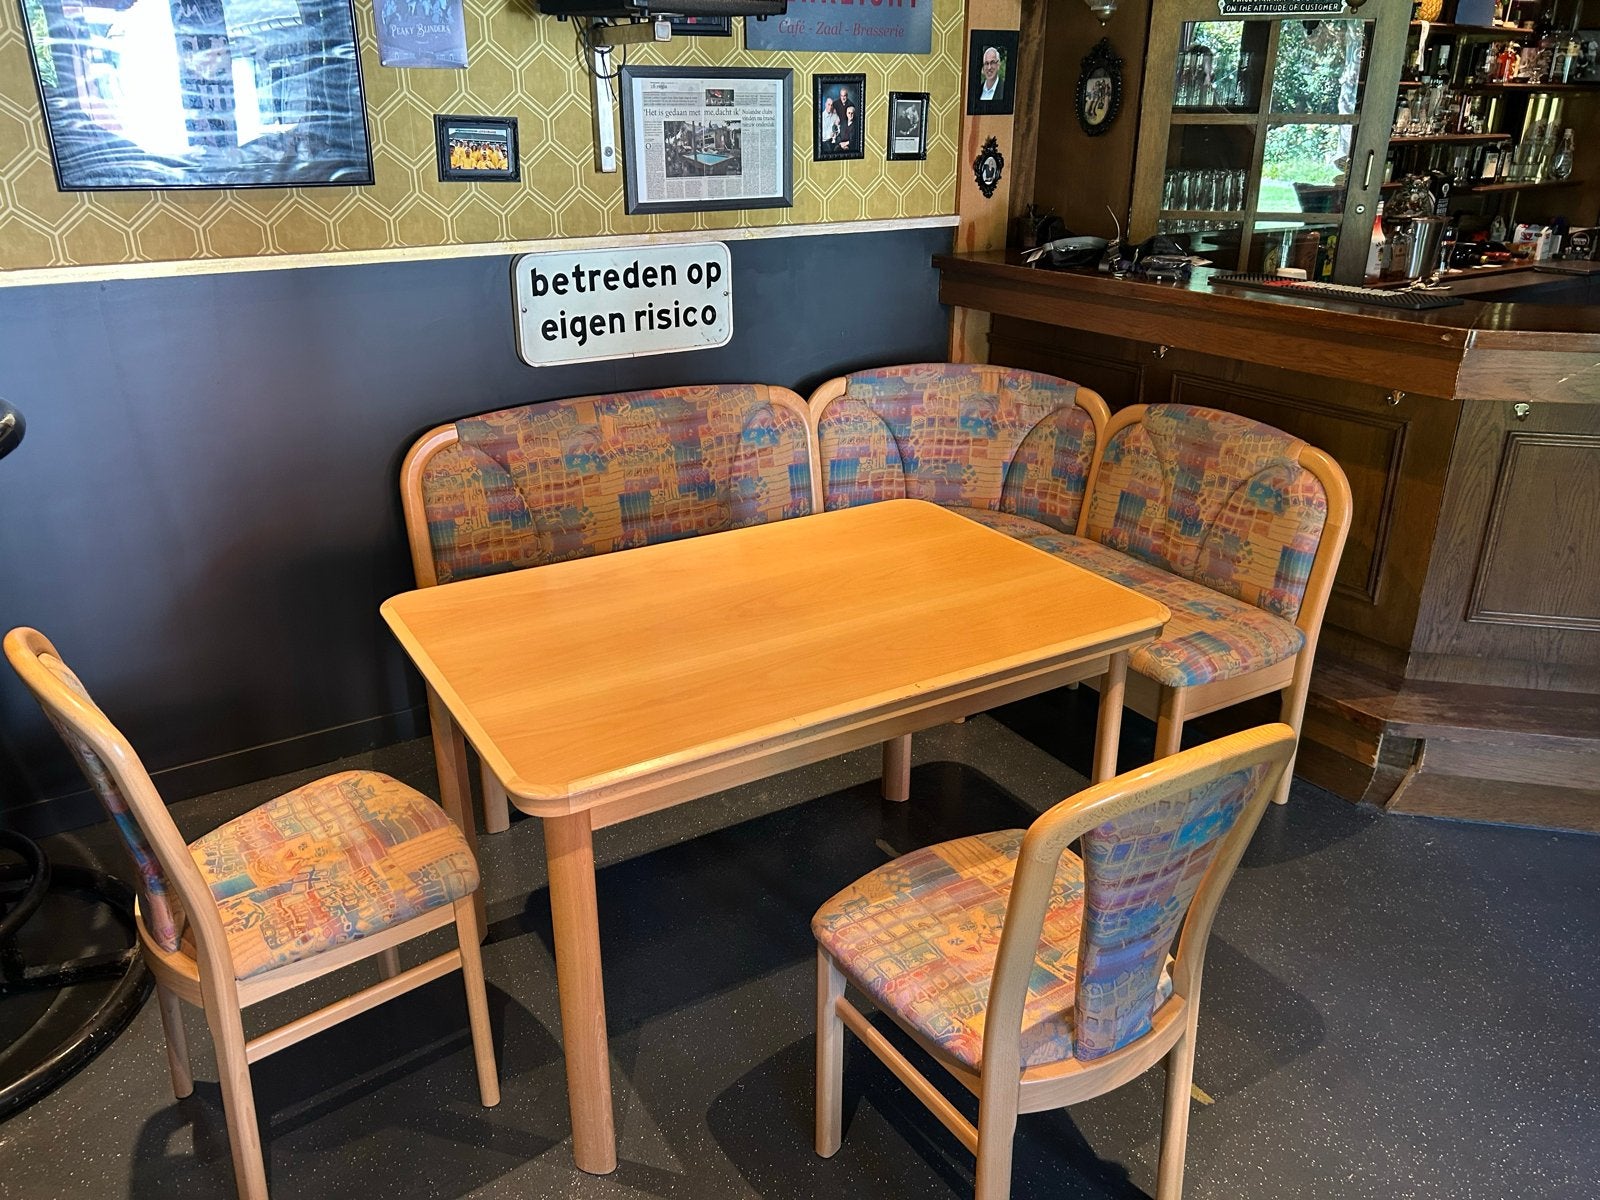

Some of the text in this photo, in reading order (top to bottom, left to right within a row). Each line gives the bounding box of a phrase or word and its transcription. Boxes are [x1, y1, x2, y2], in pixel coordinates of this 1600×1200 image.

[1226, 4, 1237, 12] ON
[1239, 4, 1252, 12] THE
[1253, 4, 1287, 12] ATTITUDE
[1300, 3, 1339, 11] CUSTOMER
[777, 20, 806, 37] Café
[815, 21, 843, 36] Zaal
[853, 23, 905, 38] Brasserie
[665, 109, 688, 118] gedaan
[530, 260, 722, 297] betreden op
[541, 300, 717, 347] eigen risico
